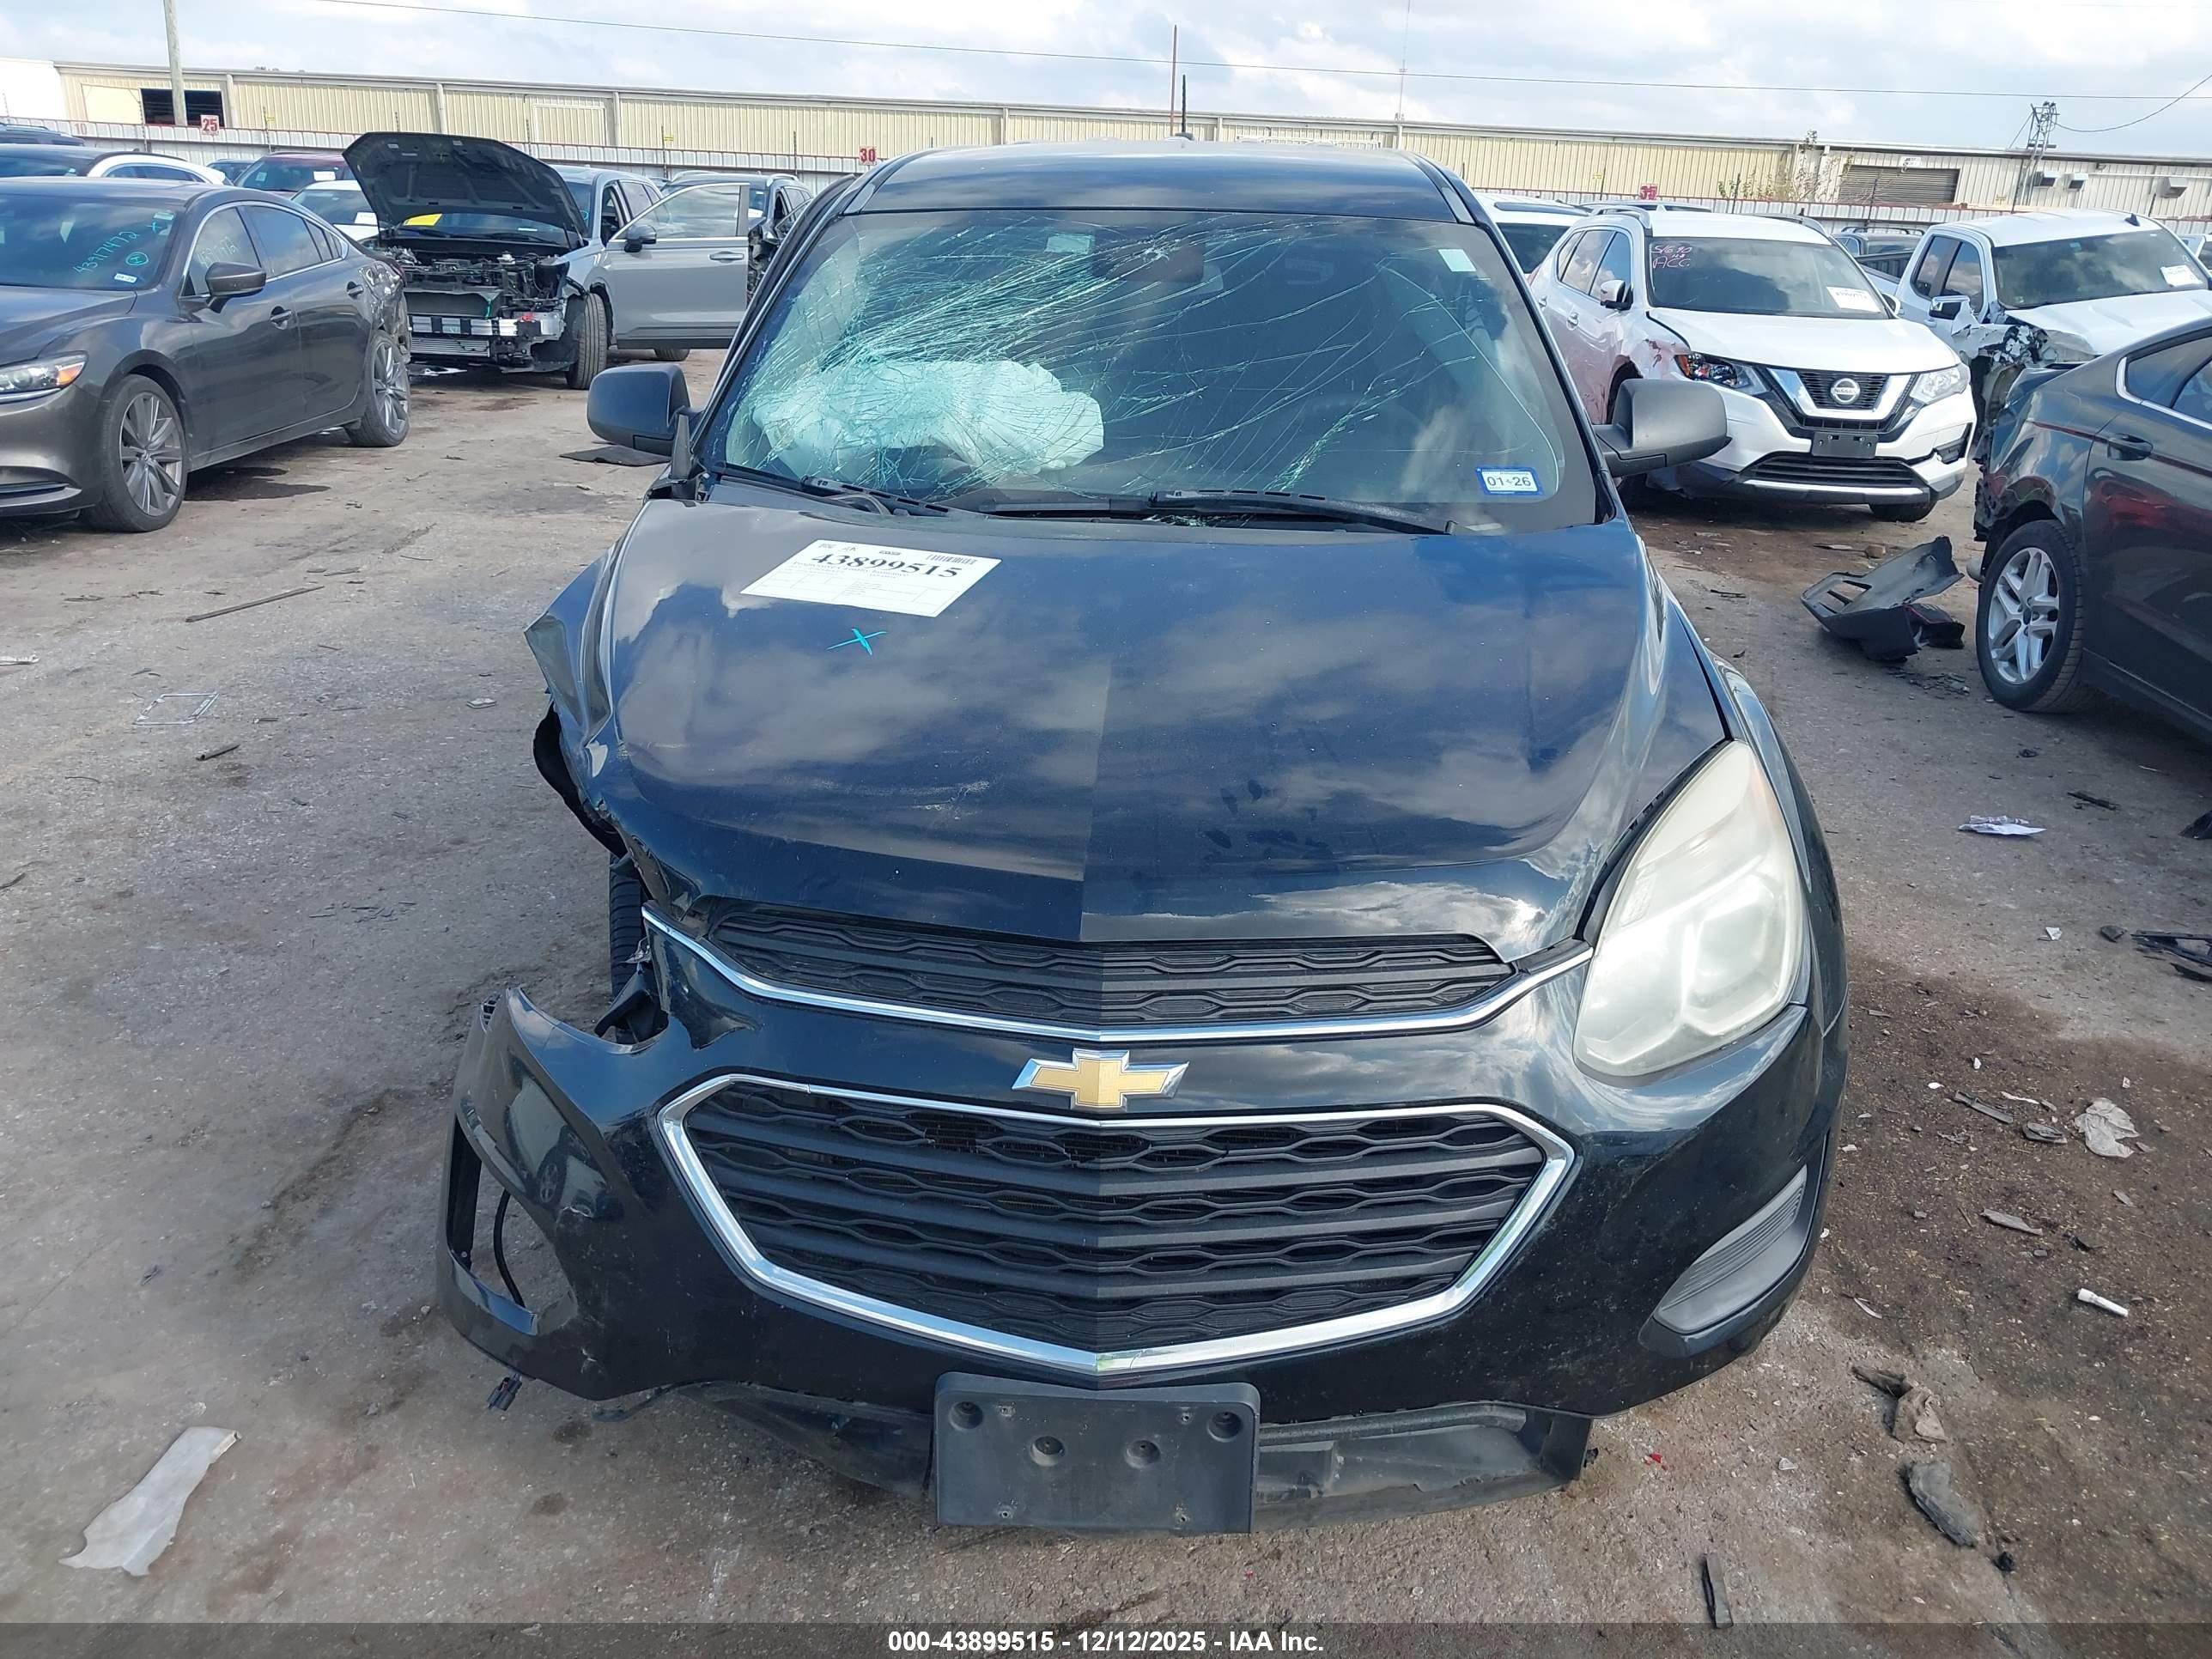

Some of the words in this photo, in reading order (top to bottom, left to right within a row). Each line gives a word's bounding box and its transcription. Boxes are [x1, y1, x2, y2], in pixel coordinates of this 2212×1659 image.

[203, 118, 218, 131] 25
[860, 148, 876, 163] 30
[811, 553, 963, 578] 43899515
